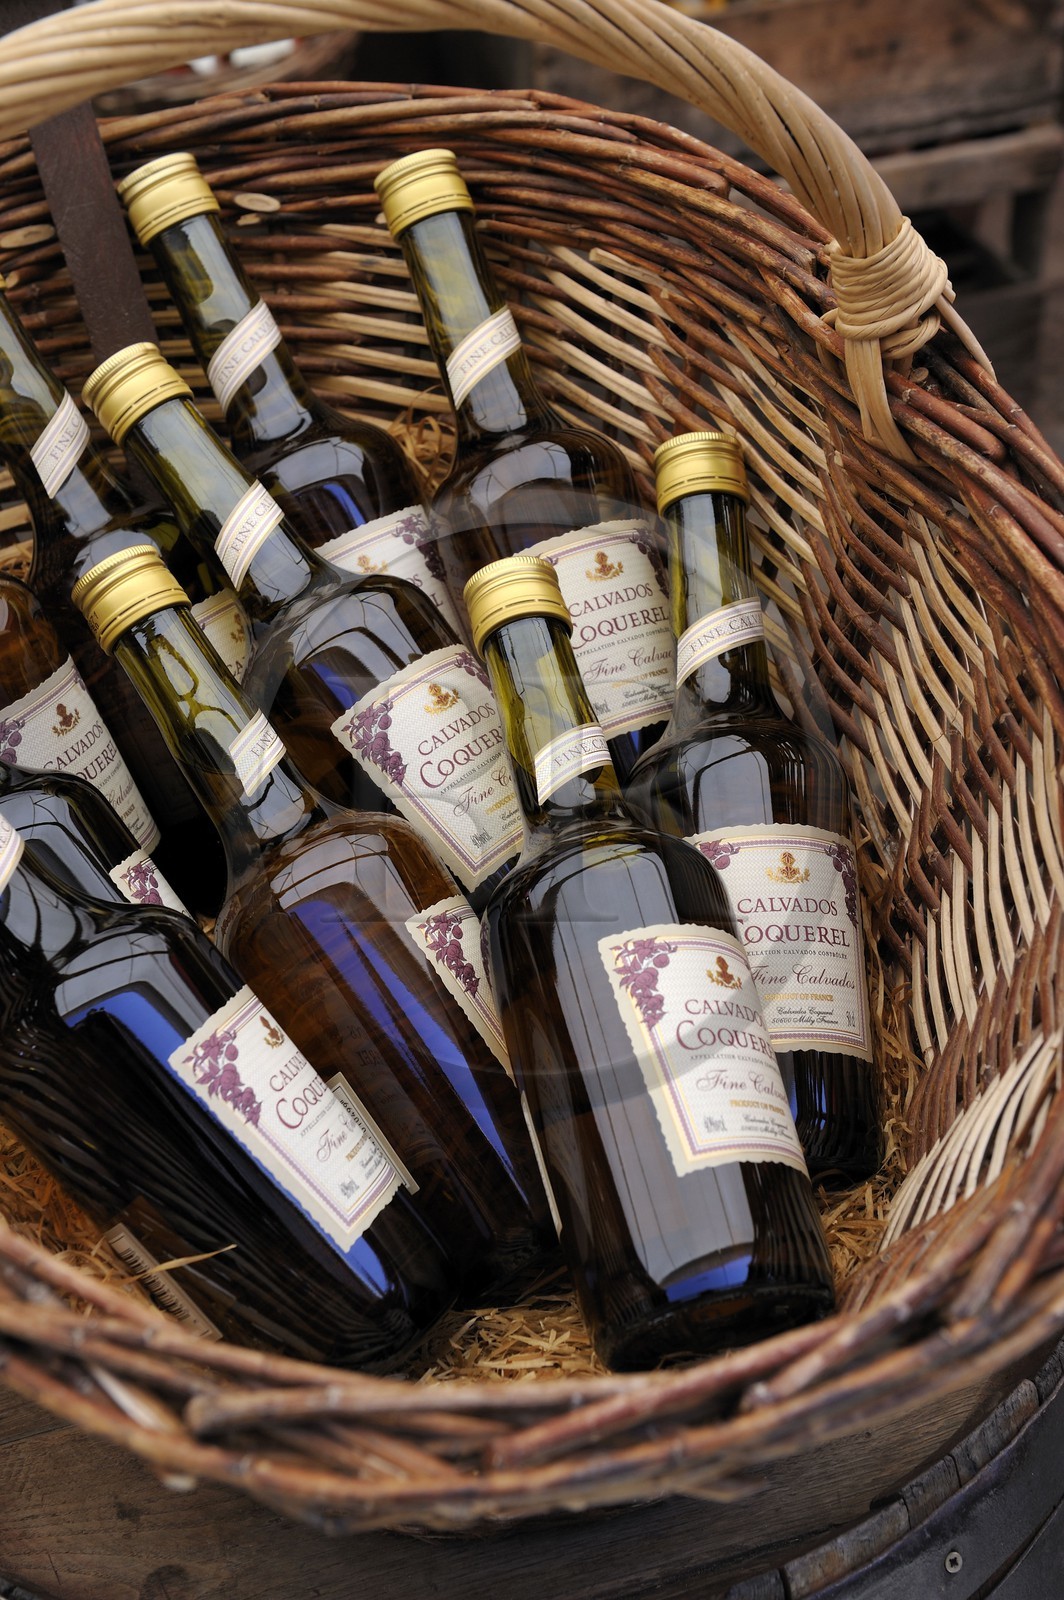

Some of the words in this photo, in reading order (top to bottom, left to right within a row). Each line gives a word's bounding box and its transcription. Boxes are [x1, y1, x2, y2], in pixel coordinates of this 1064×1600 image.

[217, 351, 241, 385] FINE
[460, 343, 490, 375] FINE
[50, 427, 75, 461] FINE
[230, 516, 257, 553] FINE
[568, 582, 654, 618] CALVADOS
[575, 642, 616, 658] APPELLATION
[617, 633, 645, 646] CALVADOS
[690, 626, 725, 652] FINE
[582, 657, 626, 682] Fine
[250, 730, 275, 757] FINE
[418, 702, 497, 757] CALVADOS
[419, 724, 504, 788] COQUER
[554, 742, 591, 767] FINE
[440, 767, 477, 796] APPELLATION
[453, 786, 495, 818] Fine
[737, 896, 838, 917] CALVADOS
[738, 919, 850, 947] OQUEREL
[783, 949, 817, 957] CALVADOS
[749, 964, 788, 989] Fine
[791, 963, 856, 990] Calvados
[685, 998, 767, 1031] CALVADO
[695, 1068, 747, 1092] Fine
[316, 1128, 348, 1163] Fine
